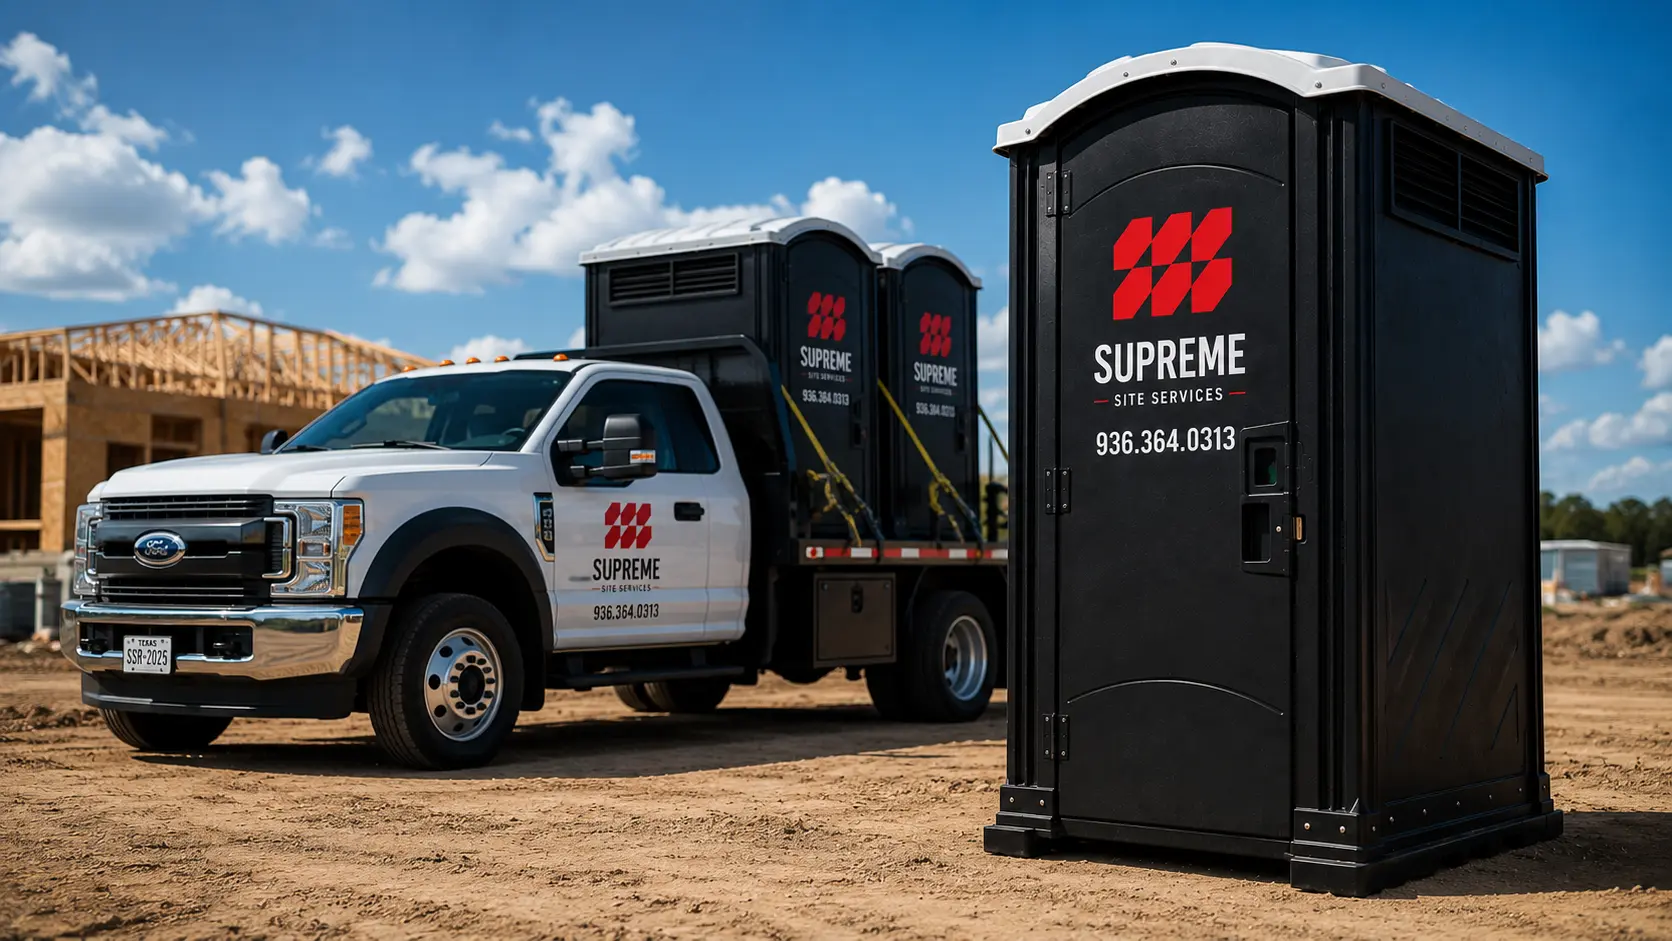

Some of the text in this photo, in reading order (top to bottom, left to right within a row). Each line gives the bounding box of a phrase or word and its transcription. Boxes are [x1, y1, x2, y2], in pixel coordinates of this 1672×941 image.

[800, 345, 852, 373] SUPREME
[1094, 333, 1246, 384] SUPREME
[913, 361, 958, 387] SUPREME
[1114, 387, 1223, 407] SITE SERVICES
[1096, 426, 1236, 456] 936.364.0313
[592, 558, 661, 581] SUPREME
[601, 583, 652, 593] SITE SERVICES
[593, 603, 660, 620] 936.364.0313
[138, 639, 157, 647] TEXAS
